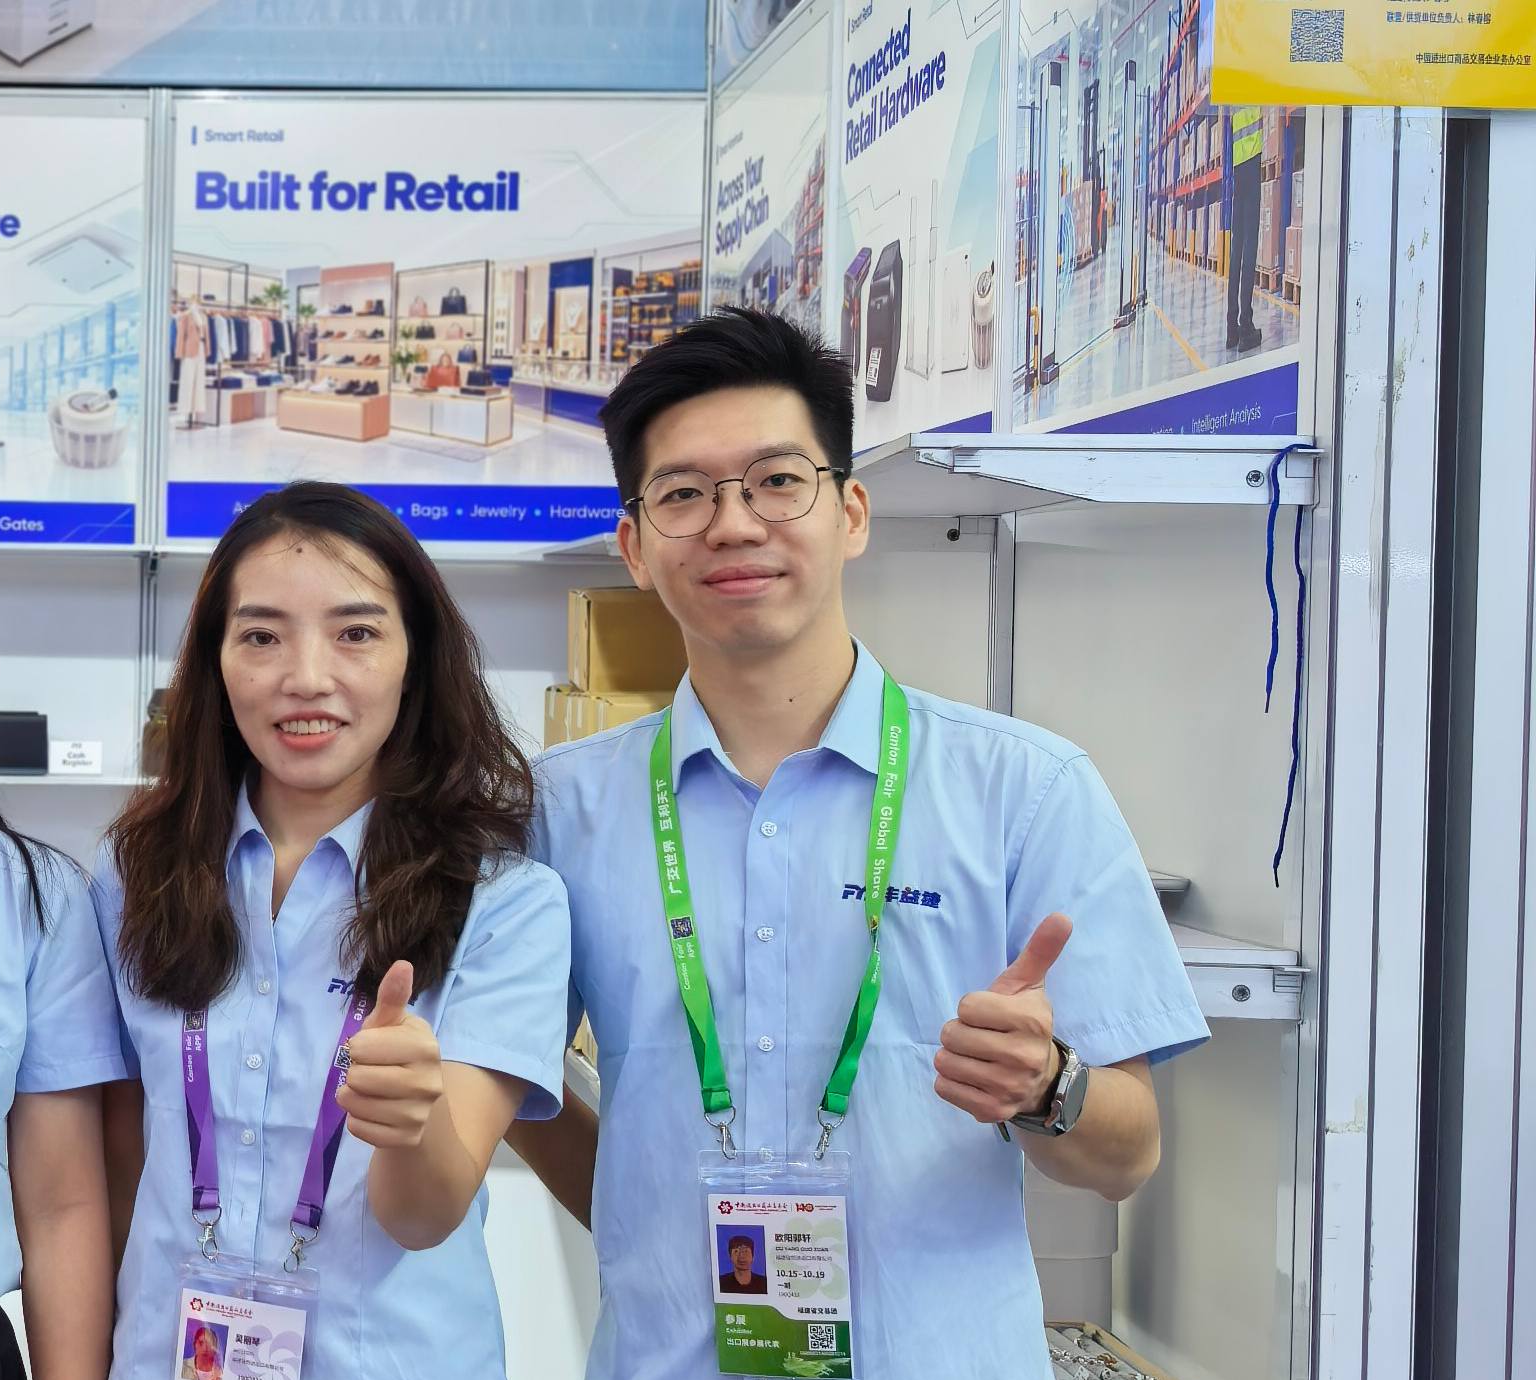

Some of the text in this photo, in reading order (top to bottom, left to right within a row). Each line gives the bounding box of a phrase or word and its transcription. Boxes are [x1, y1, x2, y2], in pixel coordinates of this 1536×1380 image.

[847, 7, 912, 108] Connected
[846, 51, 946, 165] Retail Hardware
[204, 128, 284, 143] Smart Retail
[195, 170, 520, 212] Built for Retail
[717, 172, 744, 214] Across
[716, 187, 769, 256] Supply Chain
[1192, 402, 1262, 434] Intelligent Analysis
[410, 503, 626, 520] Bags Jewelry Hardware
[872, 725, 901, 899] Canton Fair Global Share
